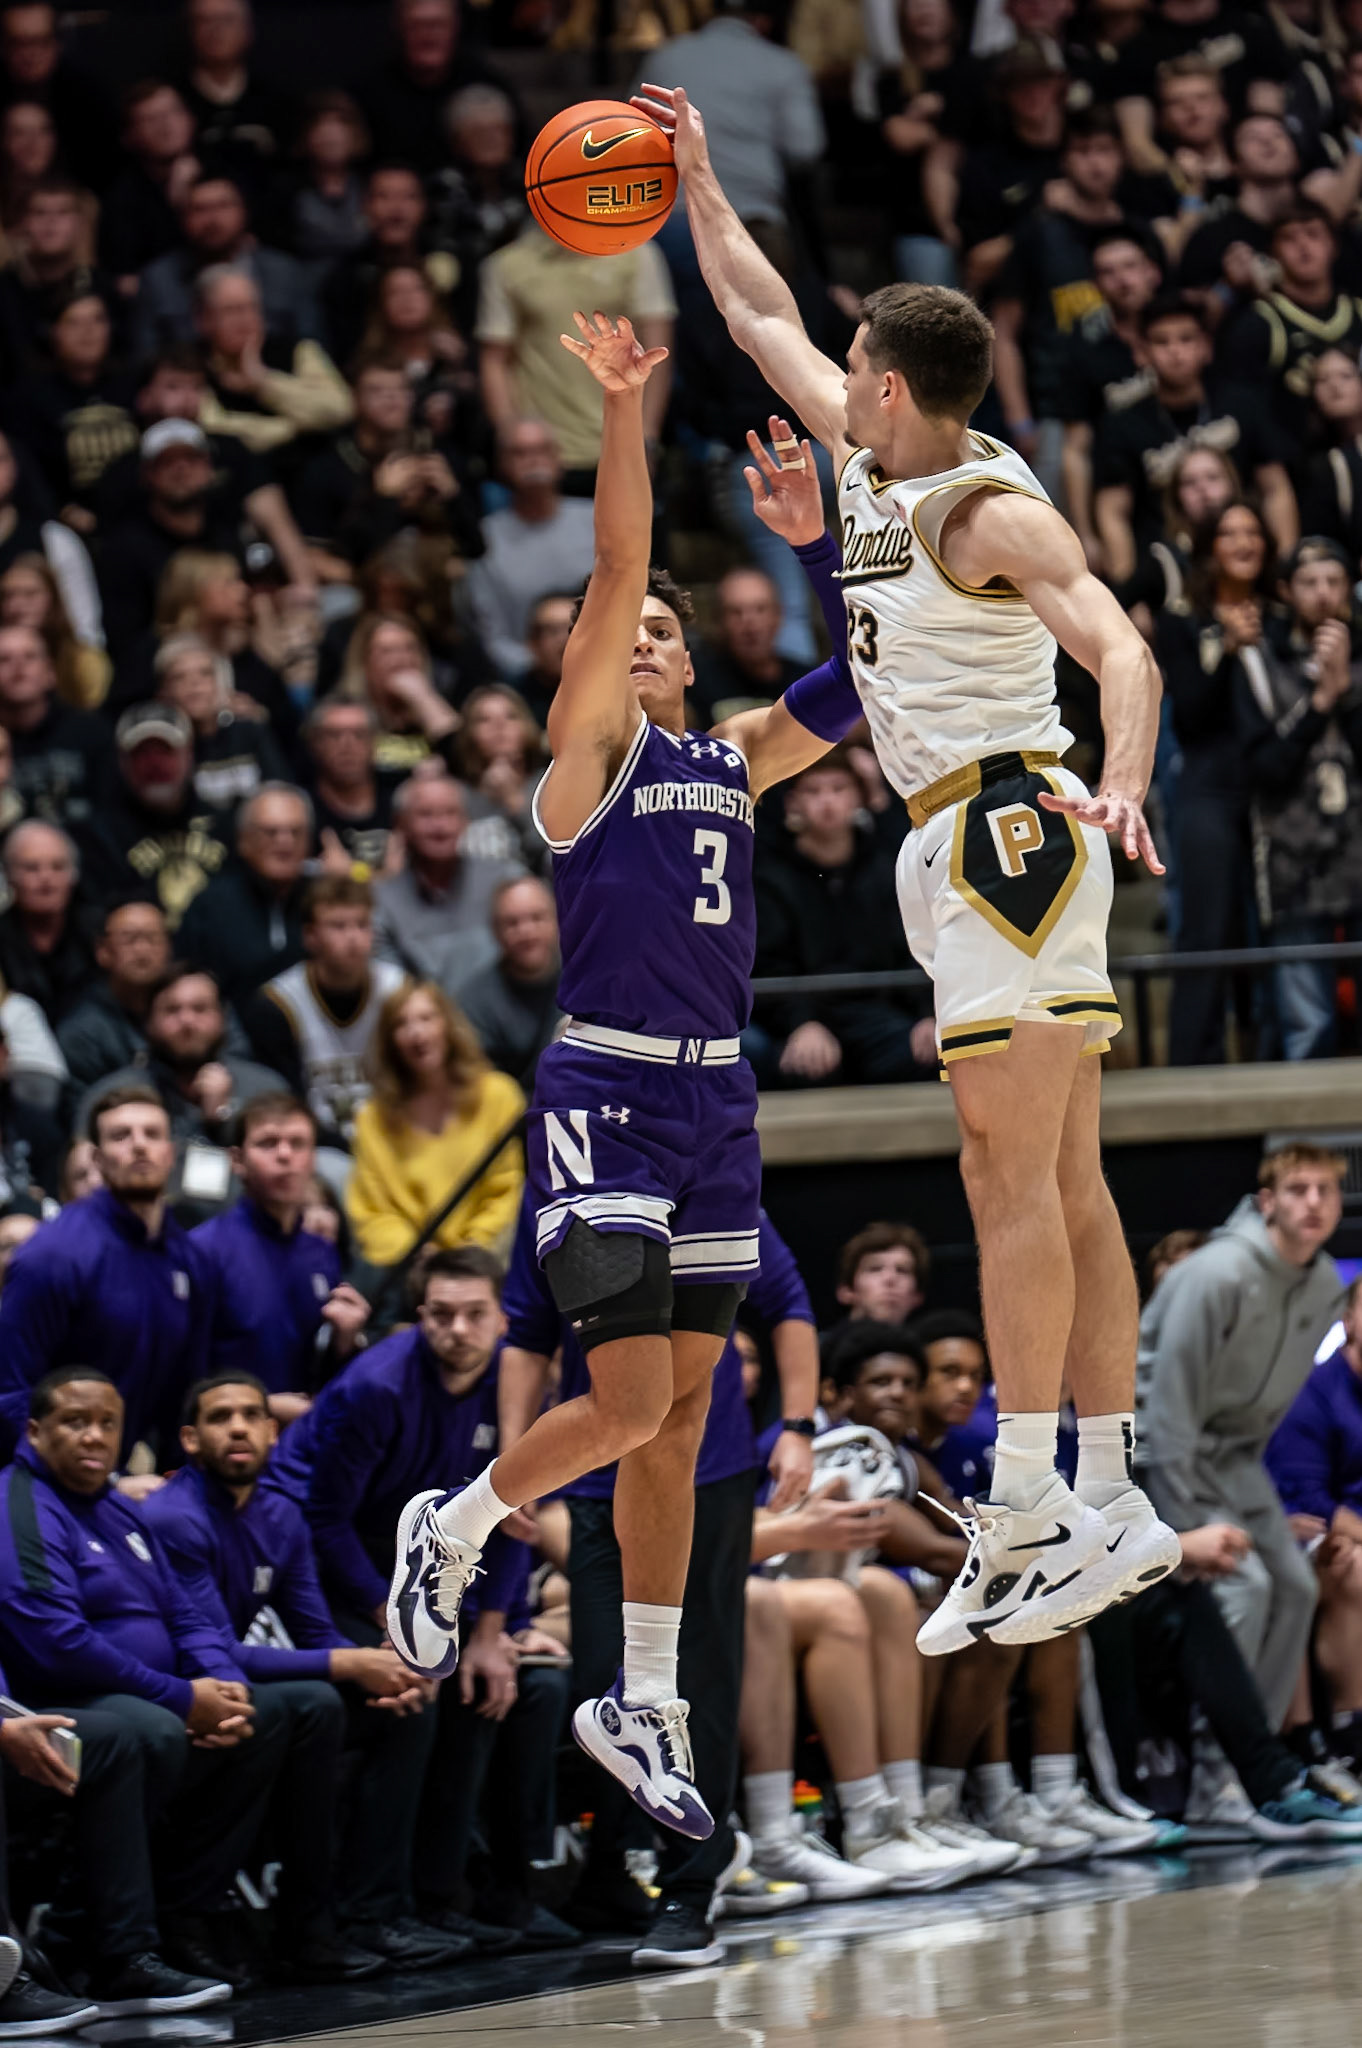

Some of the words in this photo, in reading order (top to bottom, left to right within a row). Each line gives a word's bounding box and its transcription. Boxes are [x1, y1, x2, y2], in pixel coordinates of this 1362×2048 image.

[587, 178, 662, 207] ELITE
[693, 828, 732, 925] 3
[985, 802, 1045, 877] P
[684, 1038, 701, 1063] N
[544, 1109, 594, 1191] N
